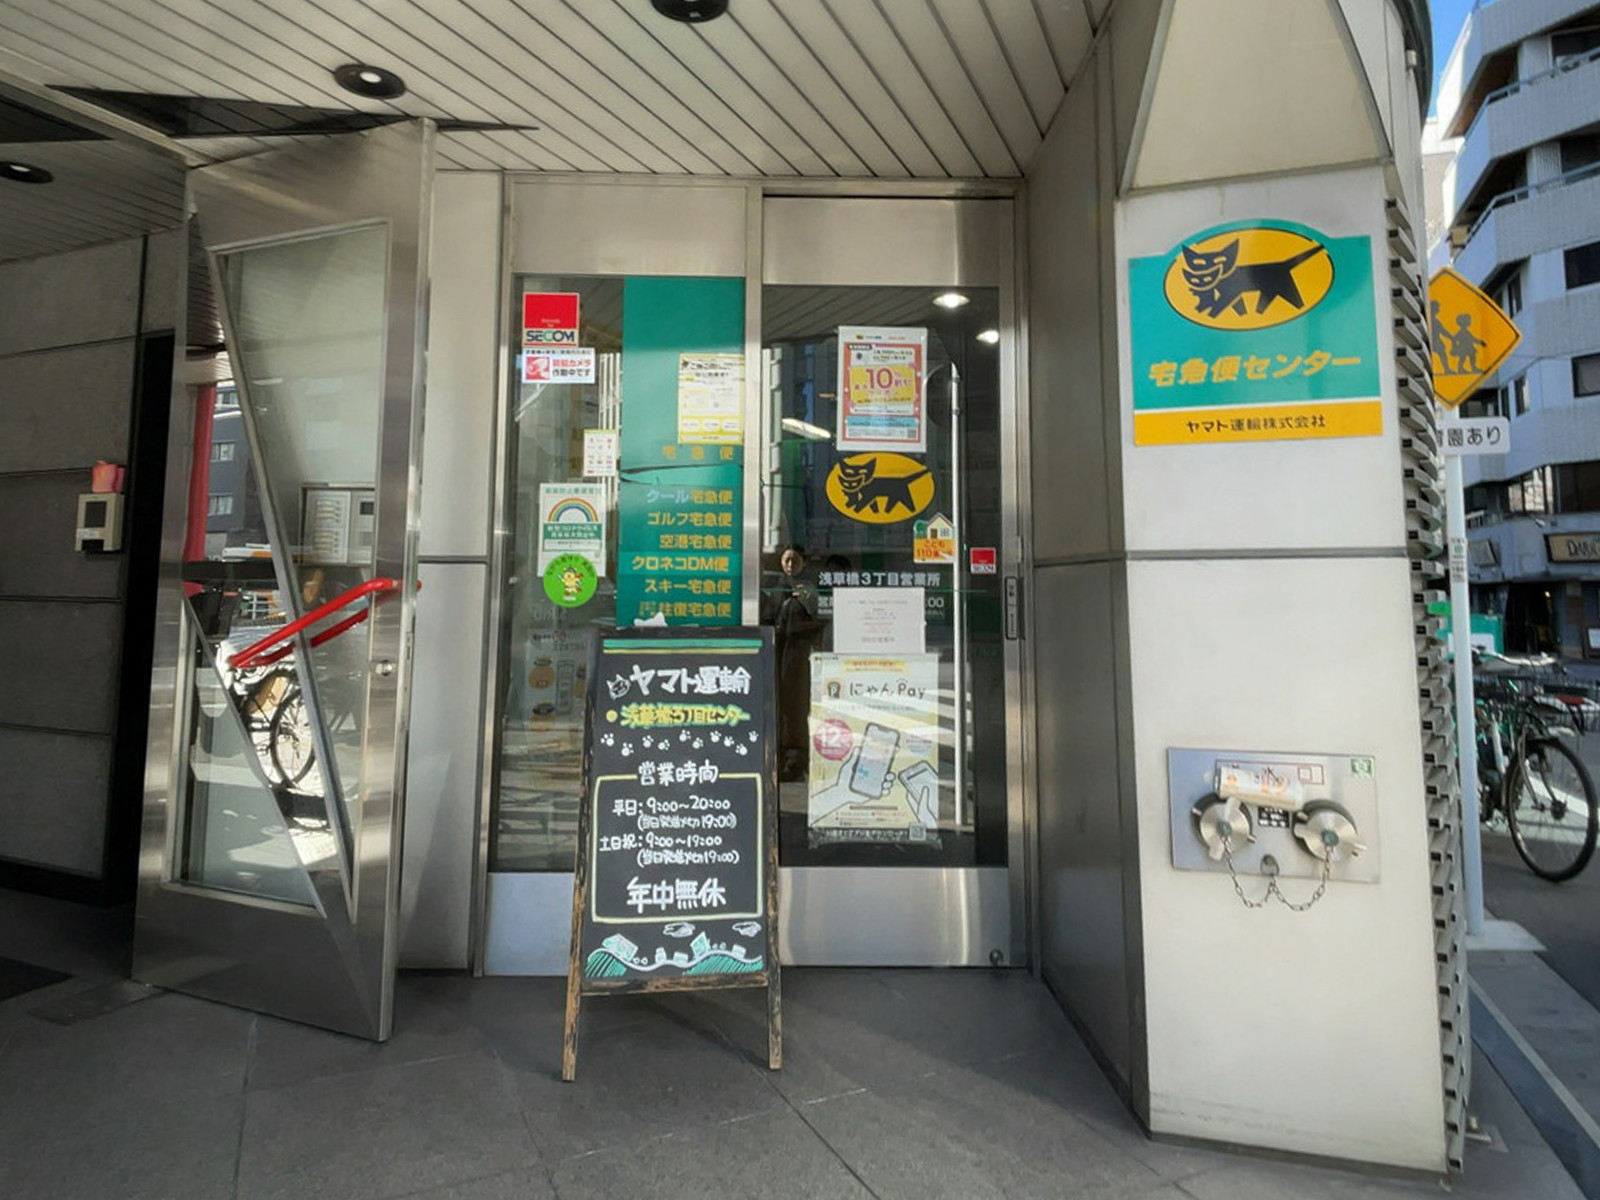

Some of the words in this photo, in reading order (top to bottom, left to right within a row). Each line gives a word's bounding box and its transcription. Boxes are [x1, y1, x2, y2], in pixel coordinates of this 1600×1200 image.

[526, 329, 575, 342] SECOM
[1148, 349, 1362, 388] 宅急便センター
[866, 368, 893, 390] 10
[1186, 413, 1327, 434] ヤマト運輸株式会社
[646, 489, 733, 506] クール宅急便
[647, 511, 733, 528] ゴルフ宅急便
[659, 534, 732, 550] 空港宅急便
[632, 555, 729, 573] クロネコDM便
[645, 579, 732, 596] スキー宅急便
[626, 875, 727, 914] 年中無休
